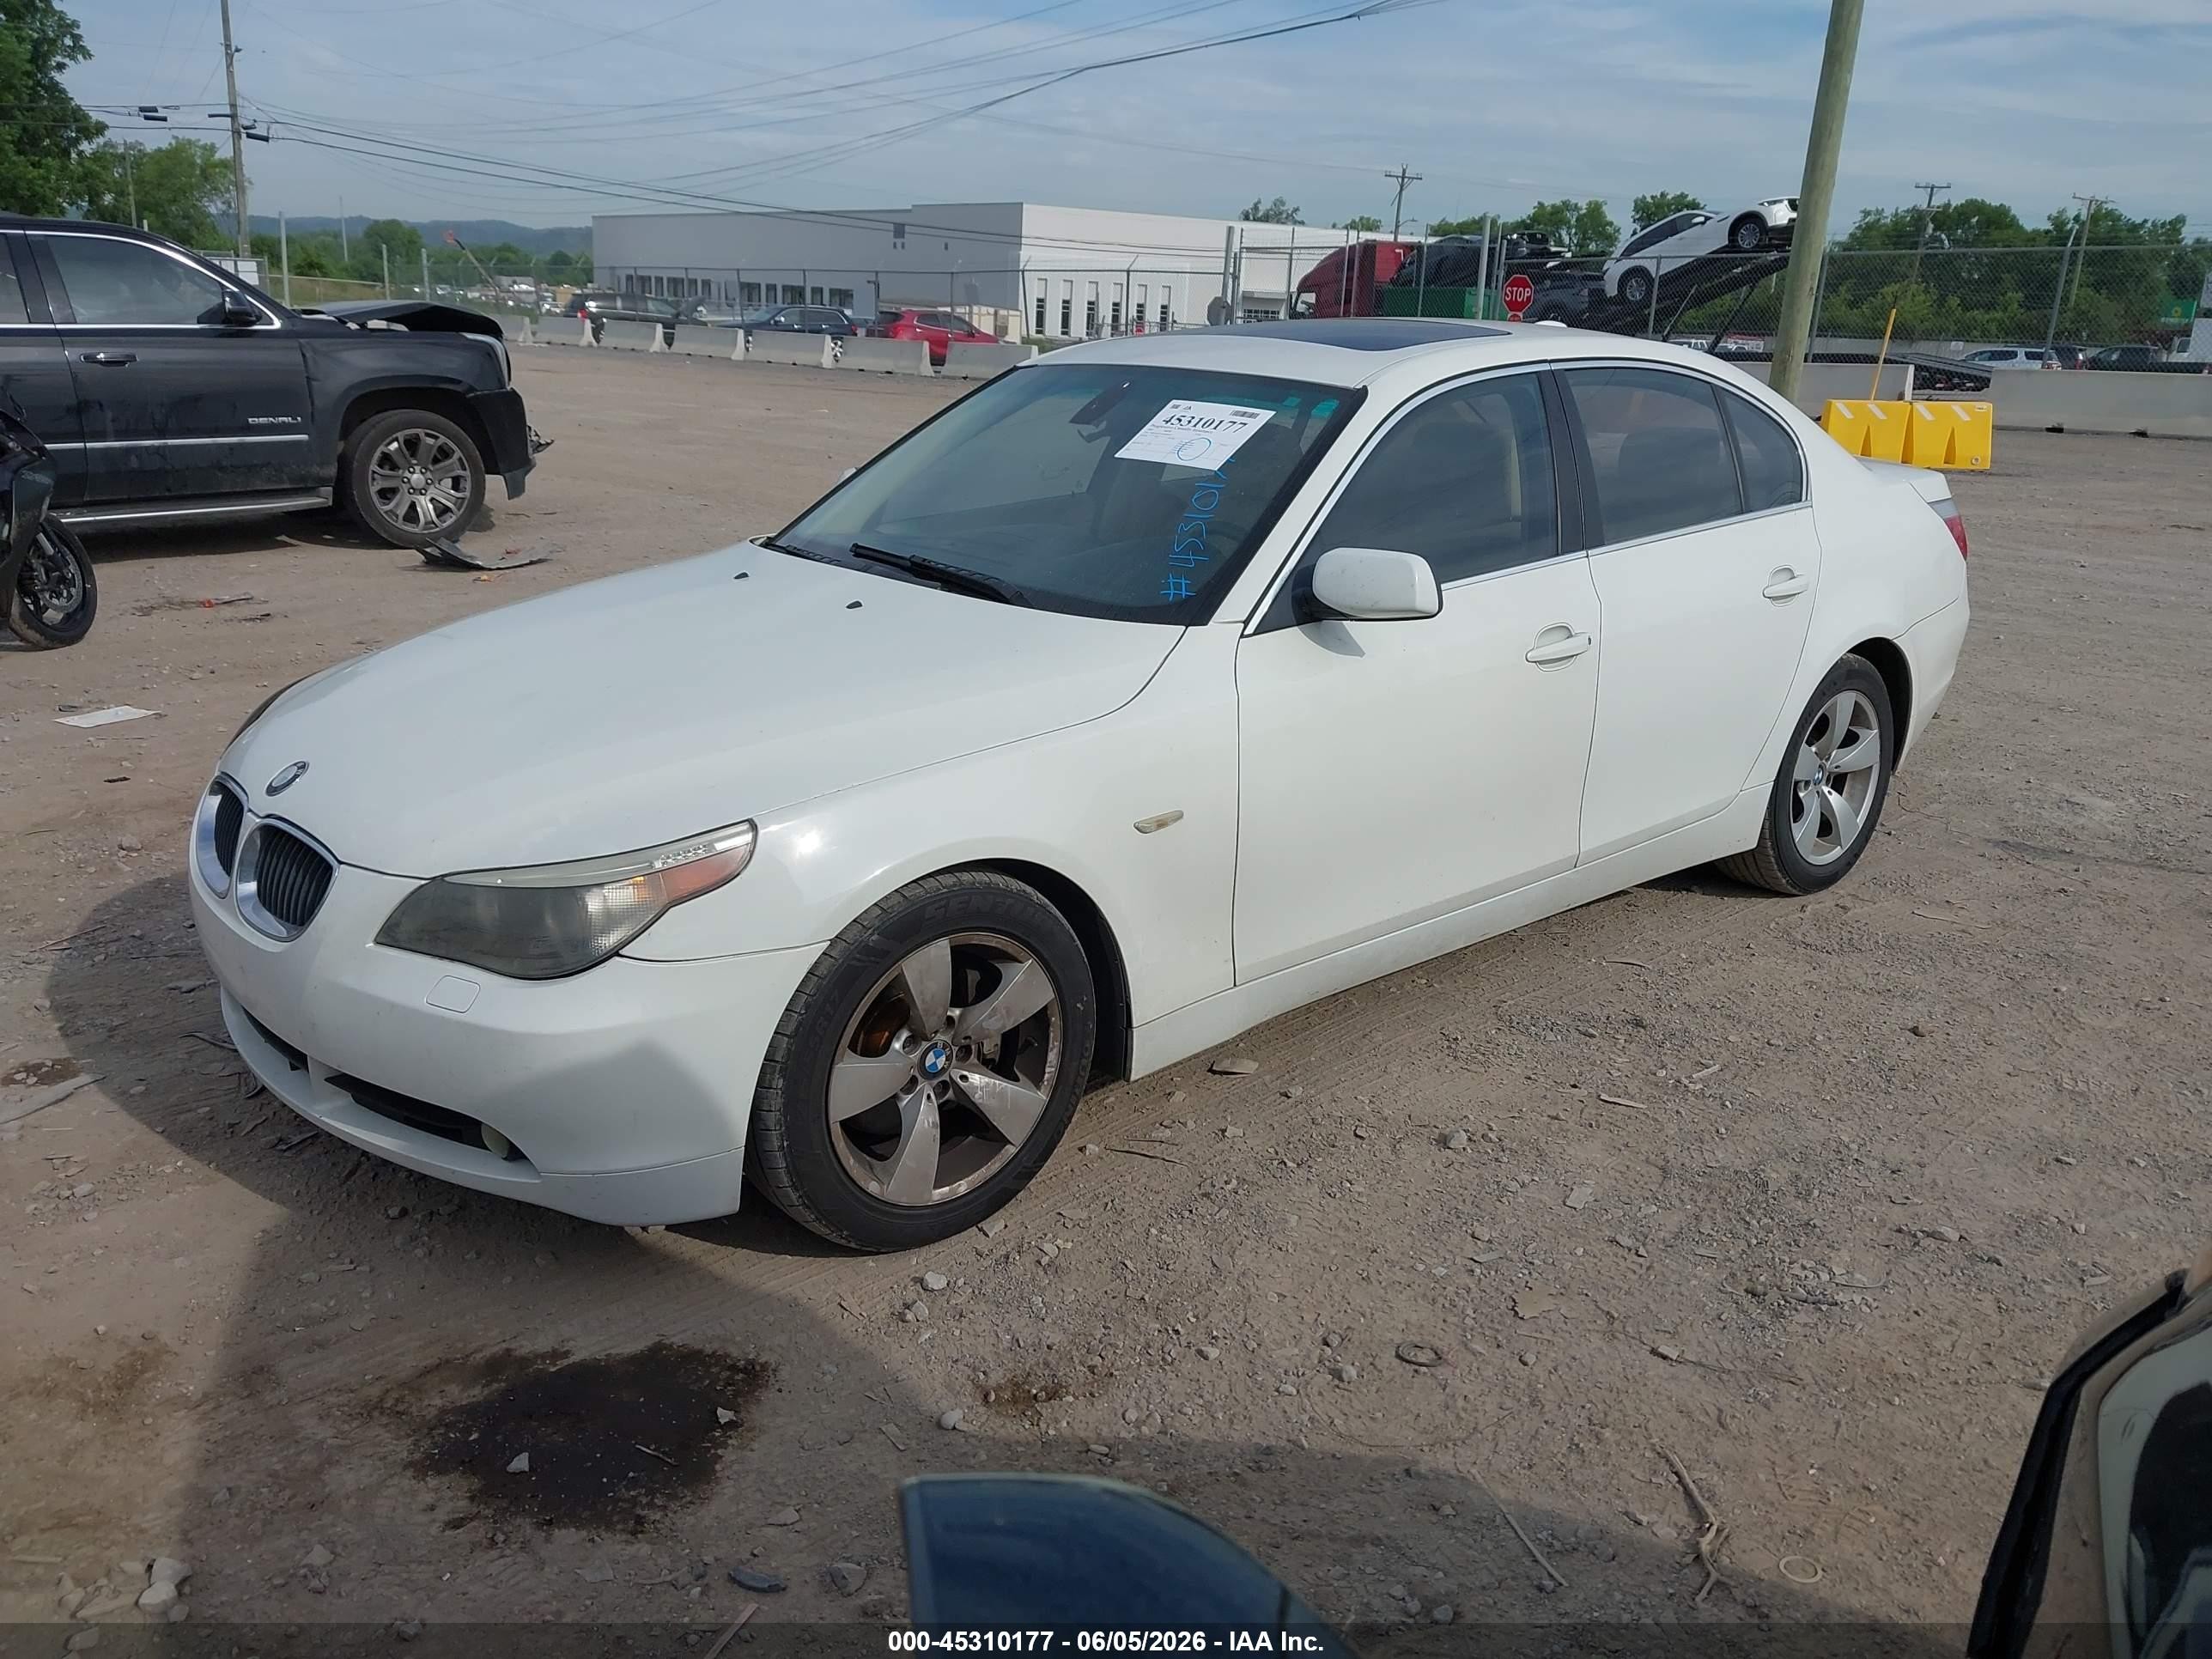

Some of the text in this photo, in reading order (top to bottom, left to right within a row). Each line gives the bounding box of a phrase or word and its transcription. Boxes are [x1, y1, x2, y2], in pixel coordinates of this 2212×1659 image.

[1504, 287, 1531, 302] STOP
[1162, 414, 1249, 433] 45310177
[1161, 457, 1236, 601] #453101
